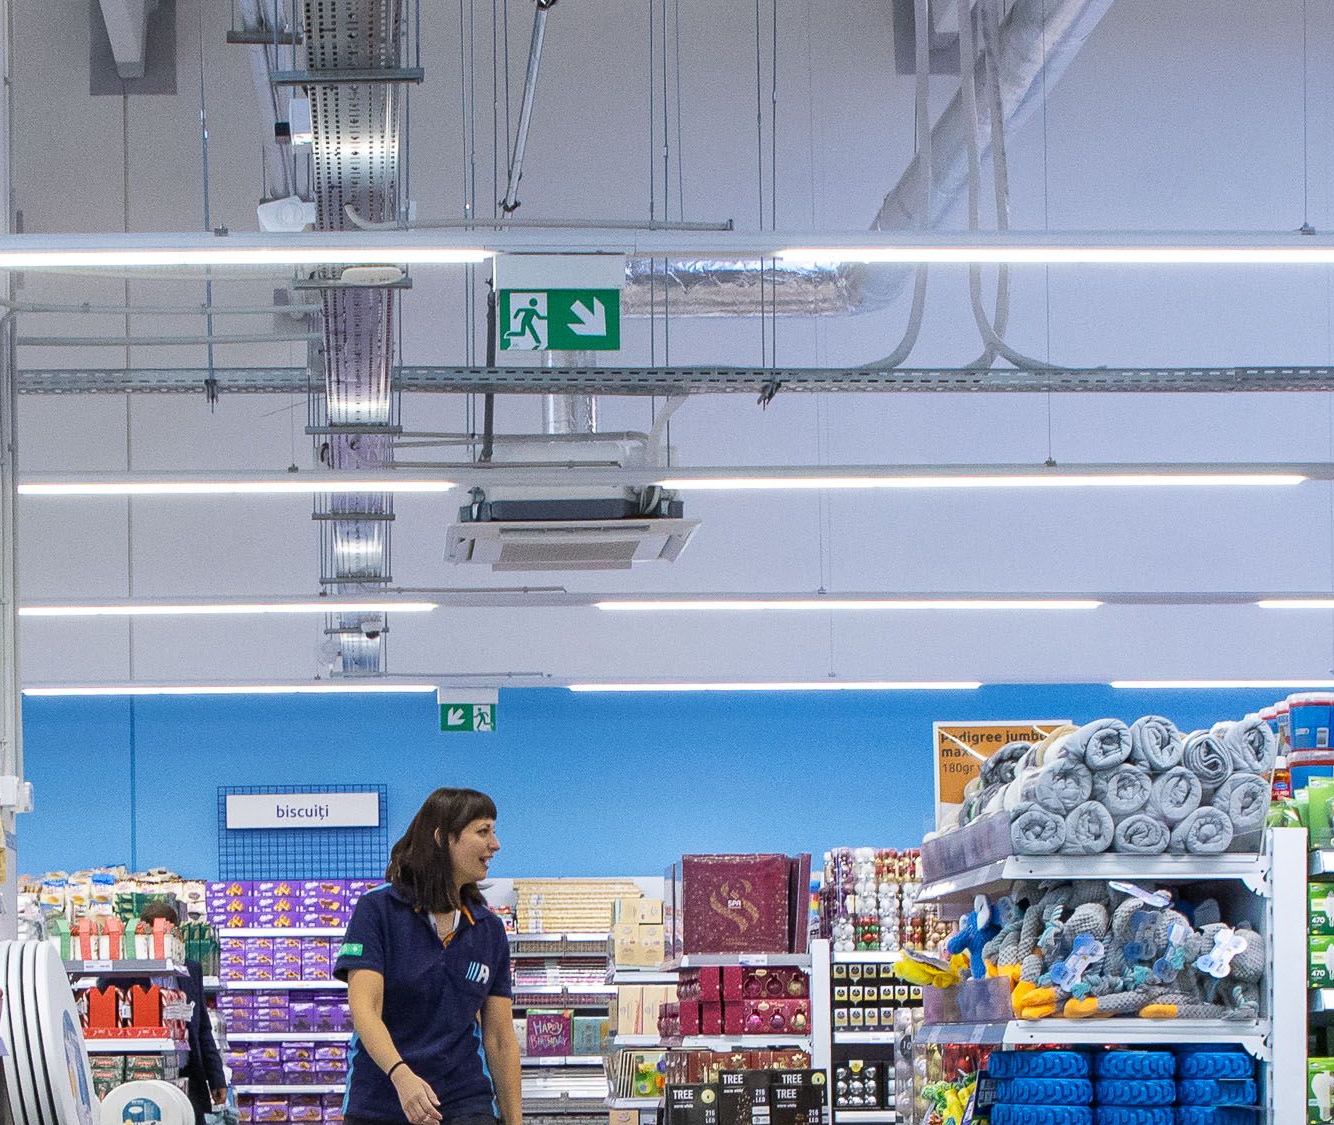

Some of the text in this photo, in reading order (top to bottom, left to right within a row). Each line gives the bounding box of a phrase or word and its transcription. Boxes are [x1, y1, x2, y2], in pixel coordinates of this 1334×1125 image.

[943, 763, 974, 775] 180gr
[275, 804, 329, 820] biscuiți
[728, 900, 741, 908] SPA
[723, 1074, 744, 1084] TREE
[782, 1074, 802, 1084] TREE
[673, 1089, 693, 1099] TREE
[776, 1089, 797, 1099] TREE
